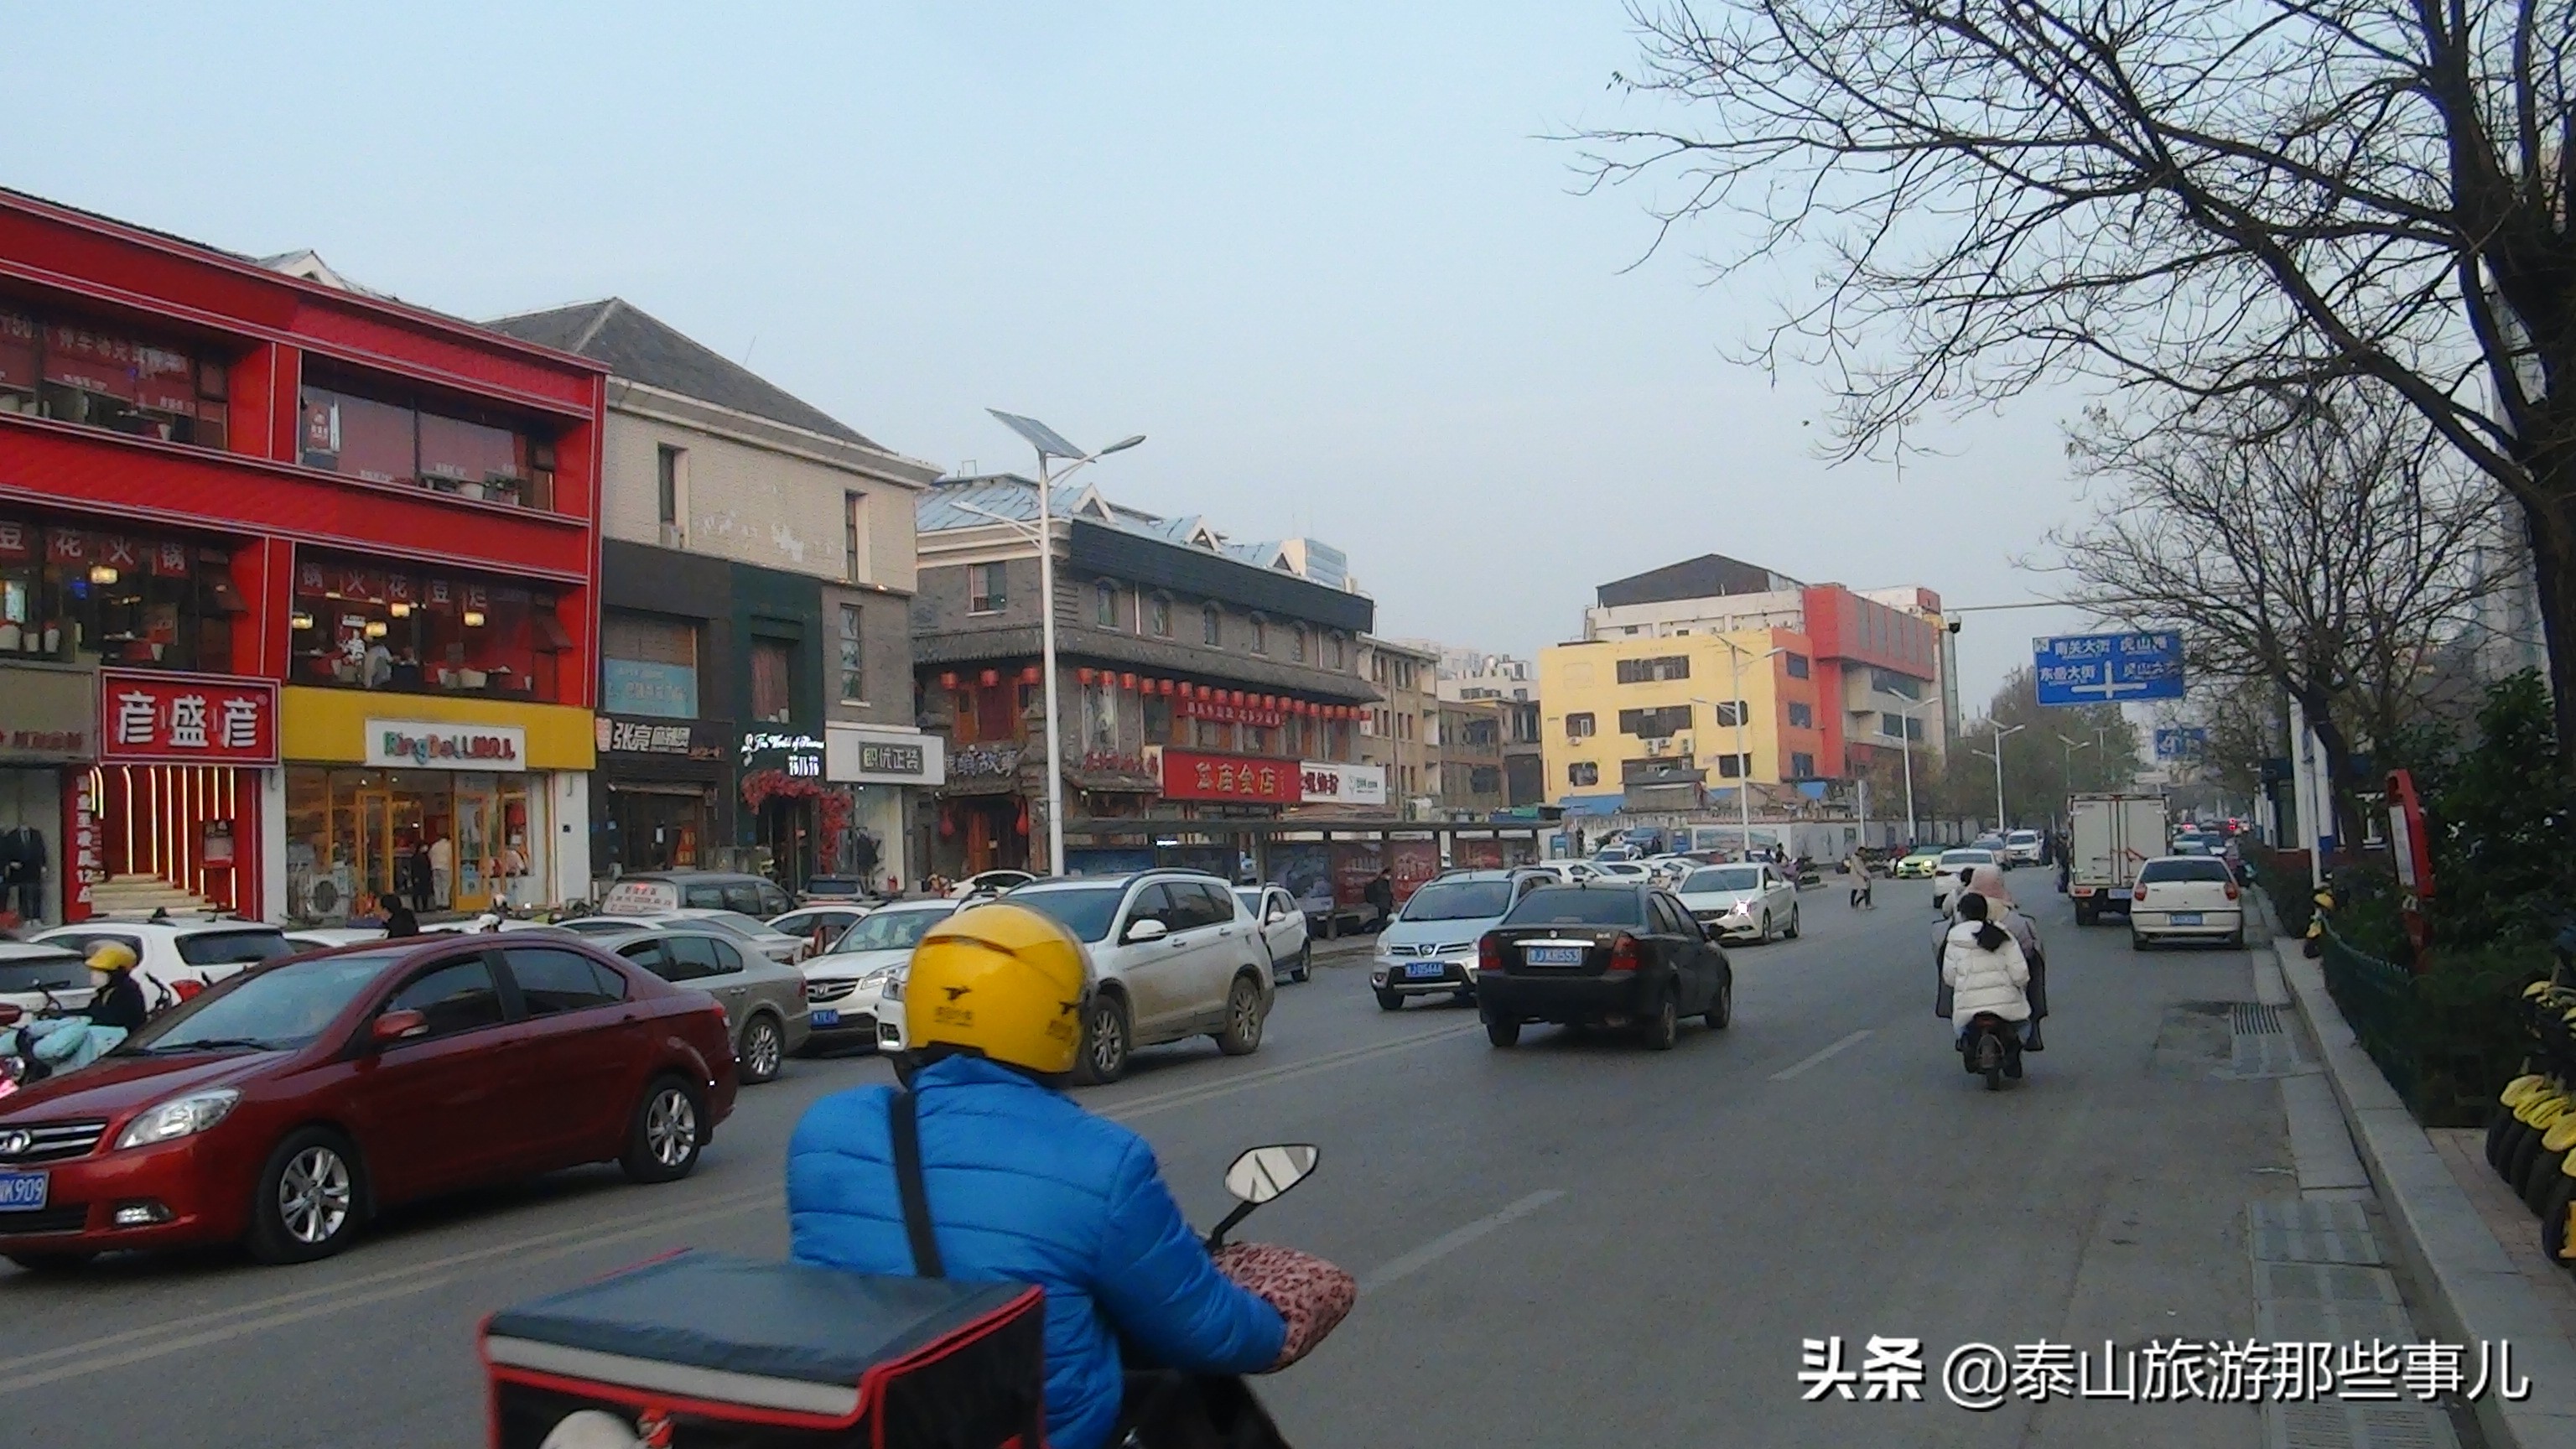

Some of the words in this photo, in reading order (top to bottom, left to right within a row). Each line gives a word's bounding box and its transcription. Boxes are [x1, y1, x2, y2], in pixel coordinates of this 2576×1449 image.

[2054, 638, 2111, 655] 南关大街
[2039, 663, 2097, 682] 东岳大街
[117, 688, 258, 749] 彦盛彦
